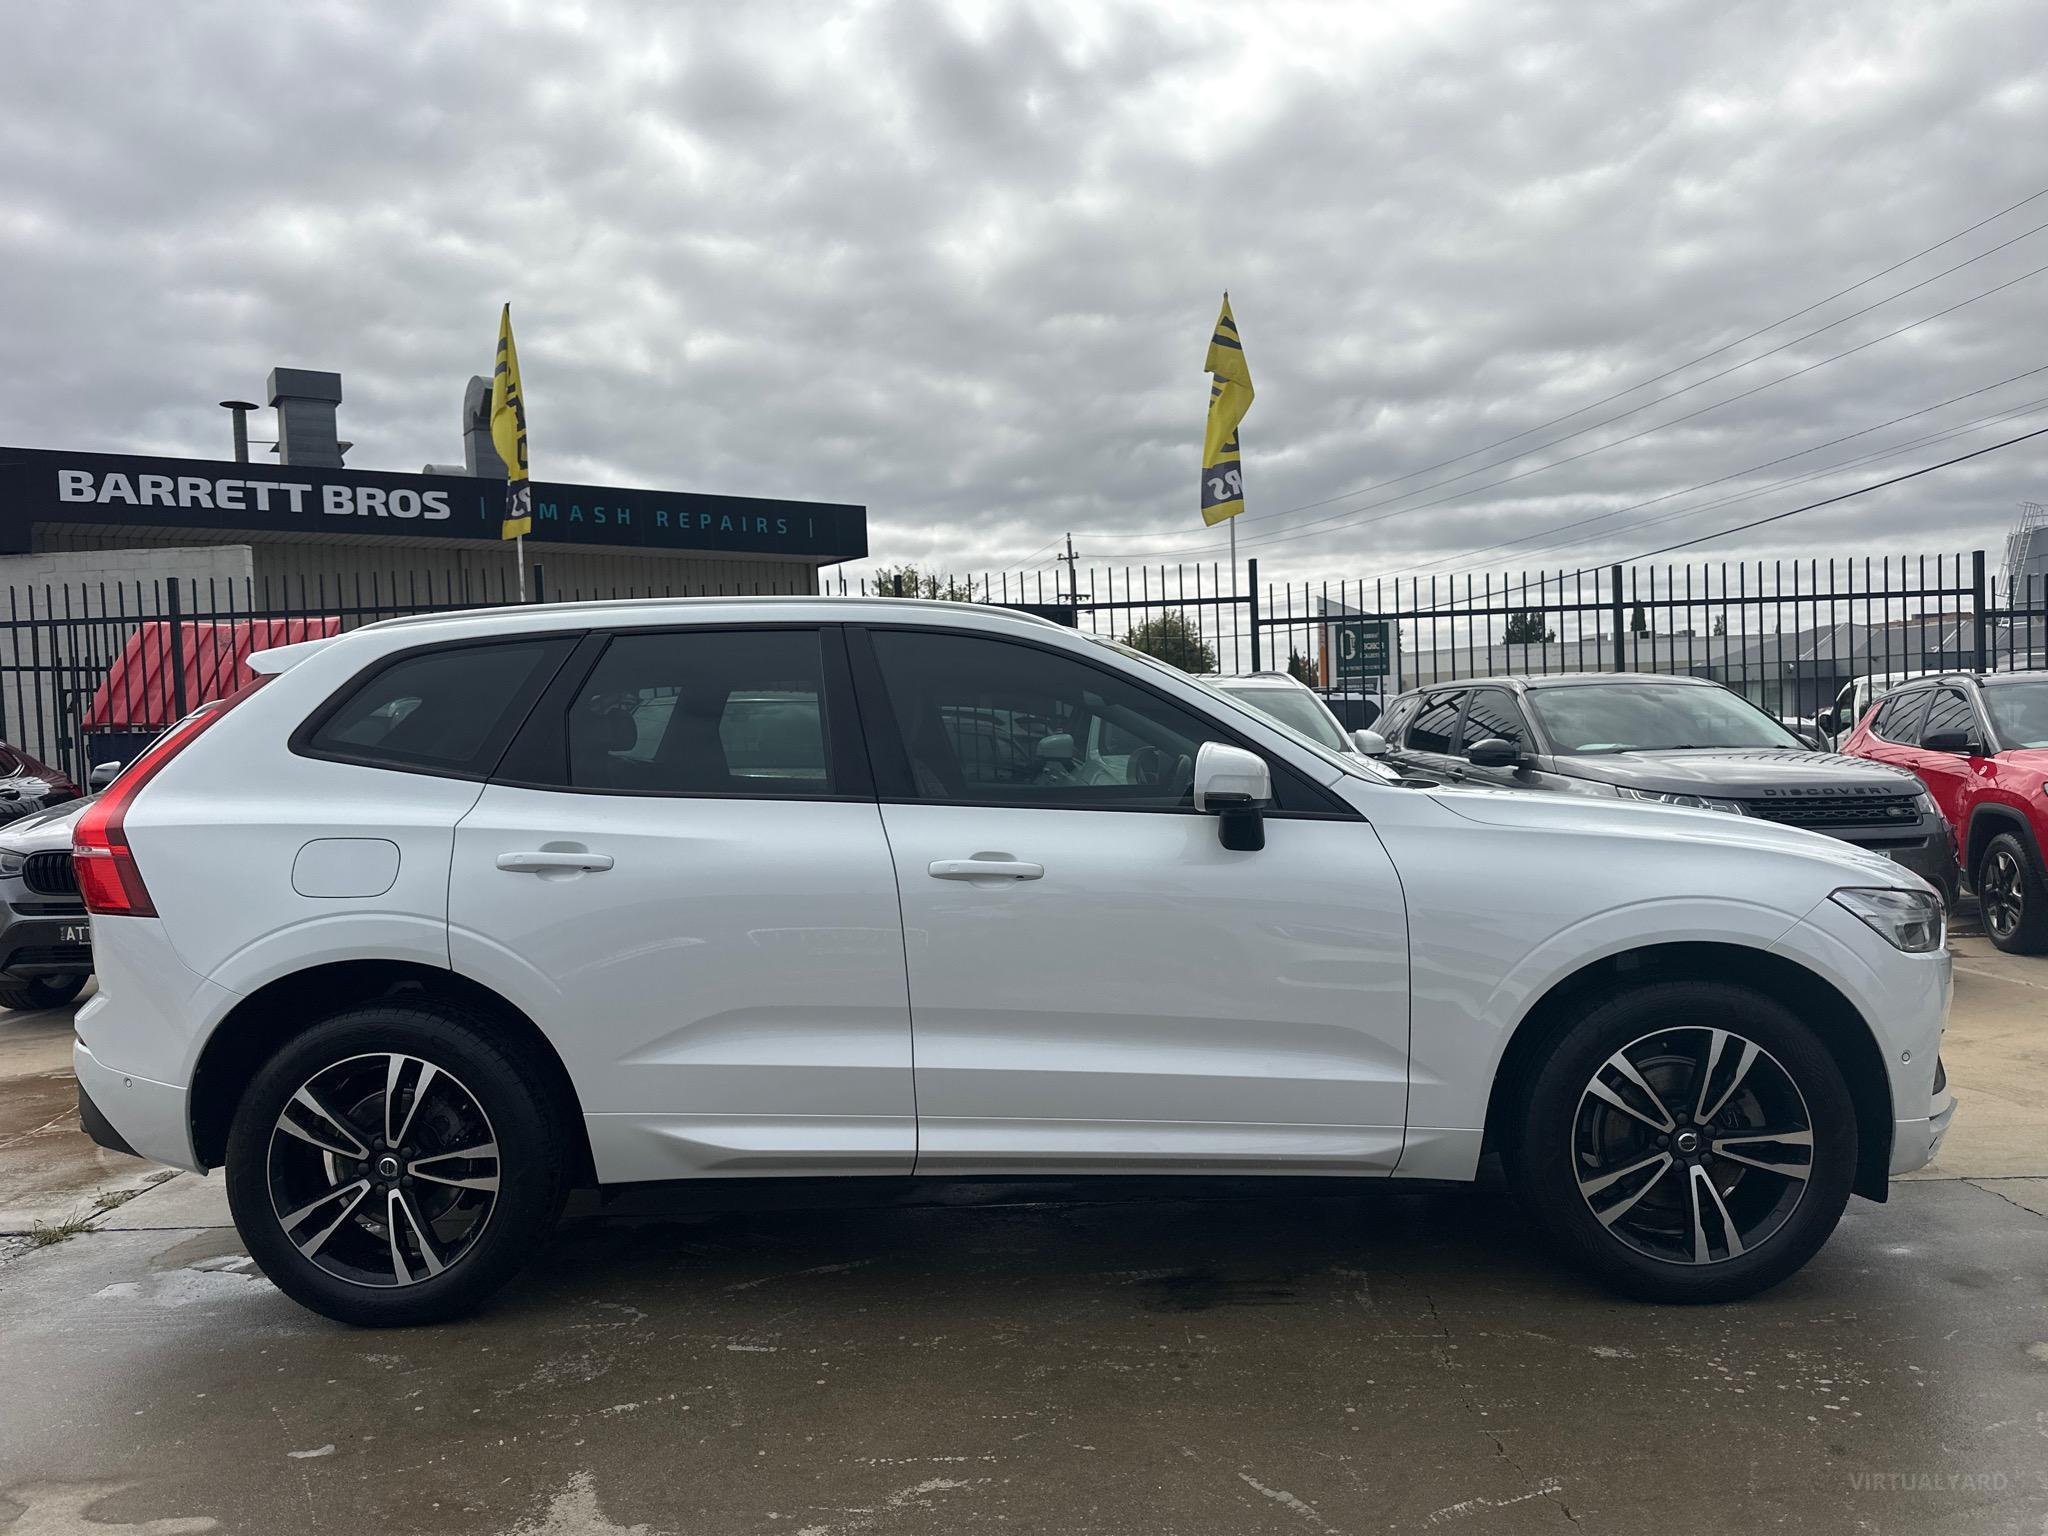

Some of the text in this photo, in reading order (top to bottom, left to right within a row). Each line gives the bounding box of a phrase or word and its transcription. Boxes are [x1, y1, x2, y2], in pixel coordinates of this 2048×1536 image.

[58, 470, 451, 519] BARRETT BROS
[539, 503, 787, 534] MASH REPAIRS
[1764, 787, 1893, 796] DISCOVERY
